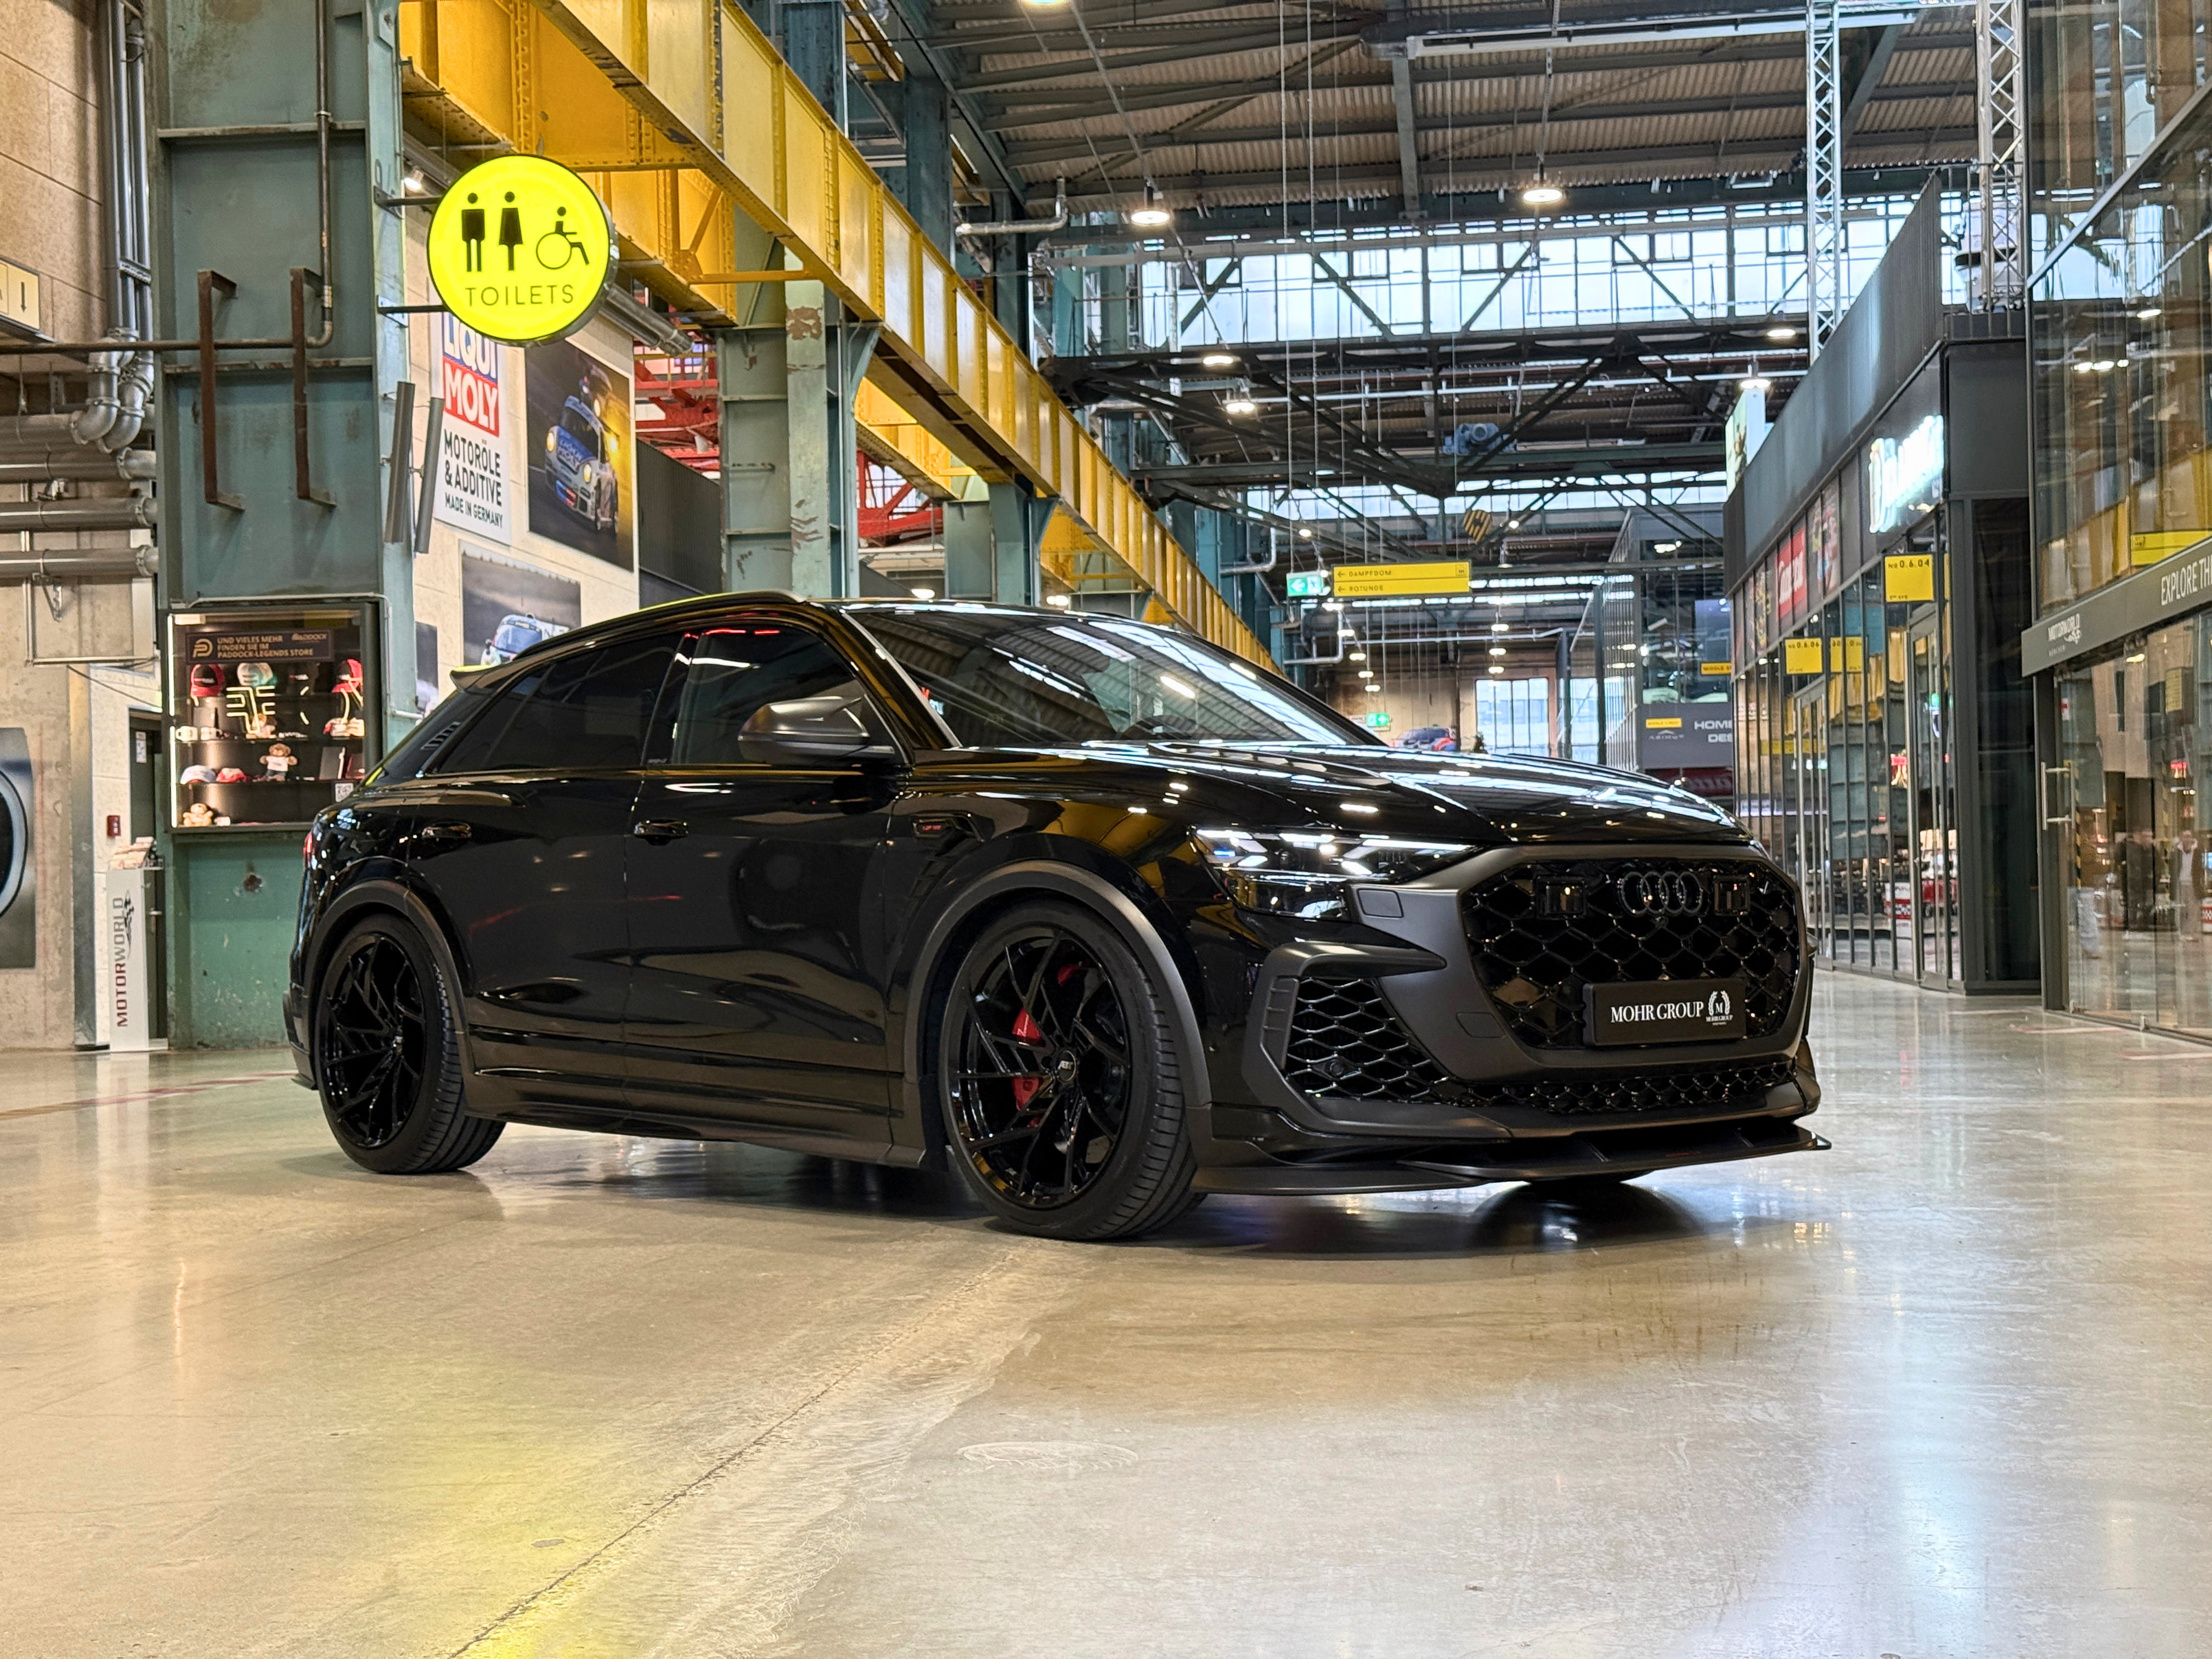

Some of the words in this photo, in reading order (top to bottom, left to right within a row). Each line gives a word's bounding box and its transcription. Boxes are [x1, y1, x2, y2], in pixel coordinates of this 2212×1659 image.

[465, 284, 573, 307] TOILETS
[444, 312, 496, 379] LIQUI
[444, 363, 498, 431] MOLY
[444, 429, 501, 478] MOTORÖLE
[445, 460, 453, 487] &
[454, 464, 502, 507] ADDITIVE
[445, 492, 464, 514] MADE
[465, 500, 472, 517] IN
[473, 495, 503, 528] GERMANY
[2162, 561, 2198, 606] EXPLORE
[217, 650, 289, 658] PADDOCK-LEGENDS
[290, 648, 314, 656] STORE
[112, 897, 128, 1028] MOTORWORLD
[1611, 1005, 1656, 1023] MOHR
[1657, 1001, 1704, 1019] GROUP
[1715, 1002, 1723, 1014] M
